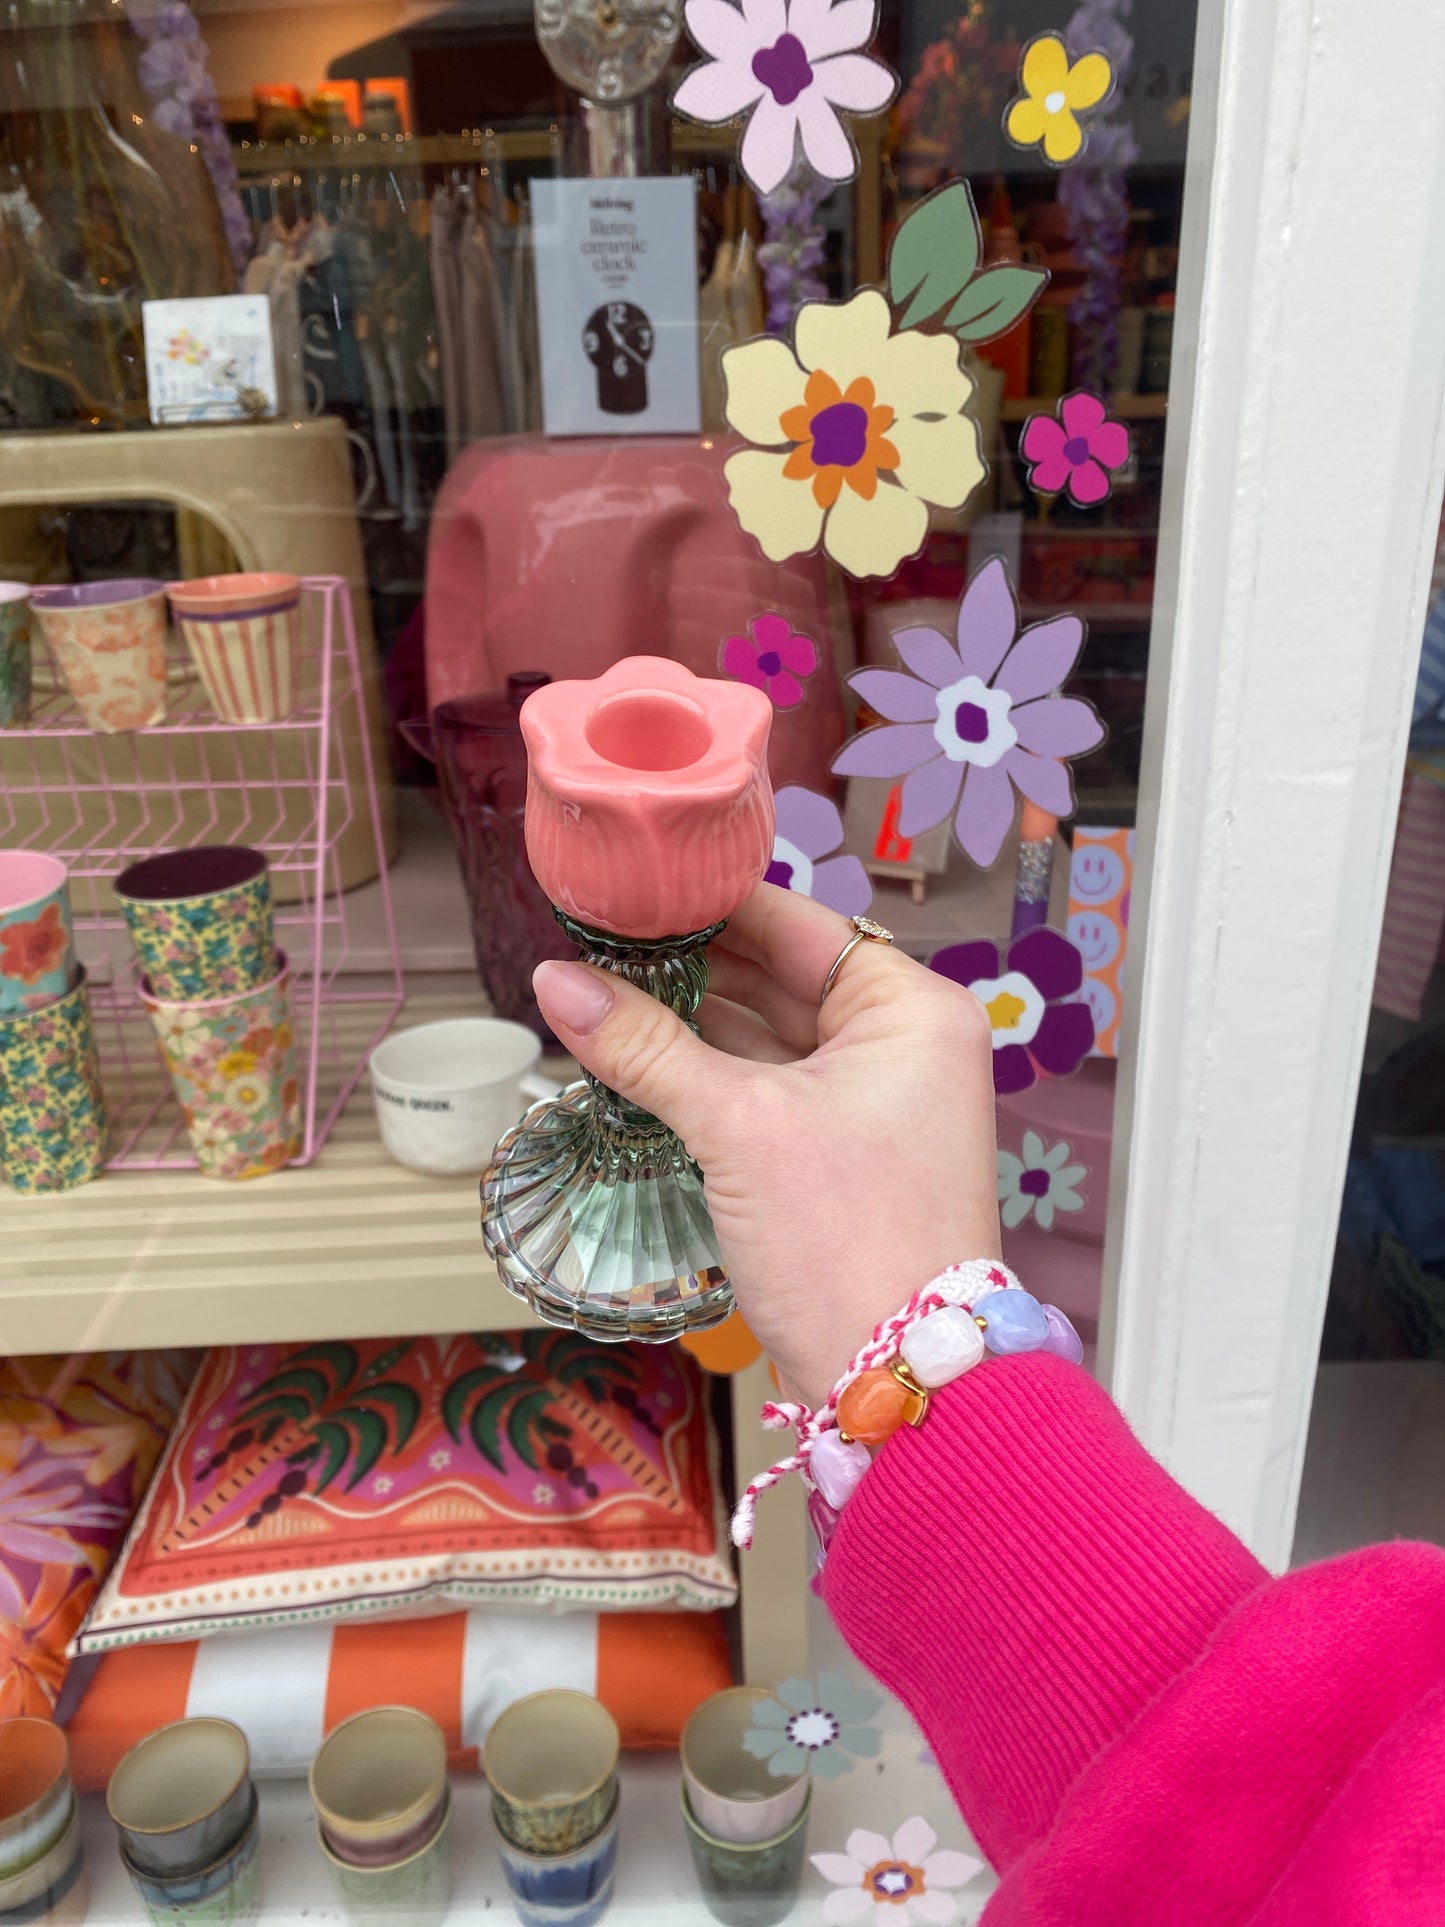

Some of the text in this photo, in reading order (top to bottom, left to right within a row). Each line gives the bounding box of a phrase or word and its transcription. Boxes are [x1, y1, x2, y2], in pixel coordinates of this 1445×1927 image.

[591, 219, 637, 235] Retro
[581, 240, 648, 255] ceramic
[592, 254, 637, 271] clock
[612, 355, 628, 377] 6
